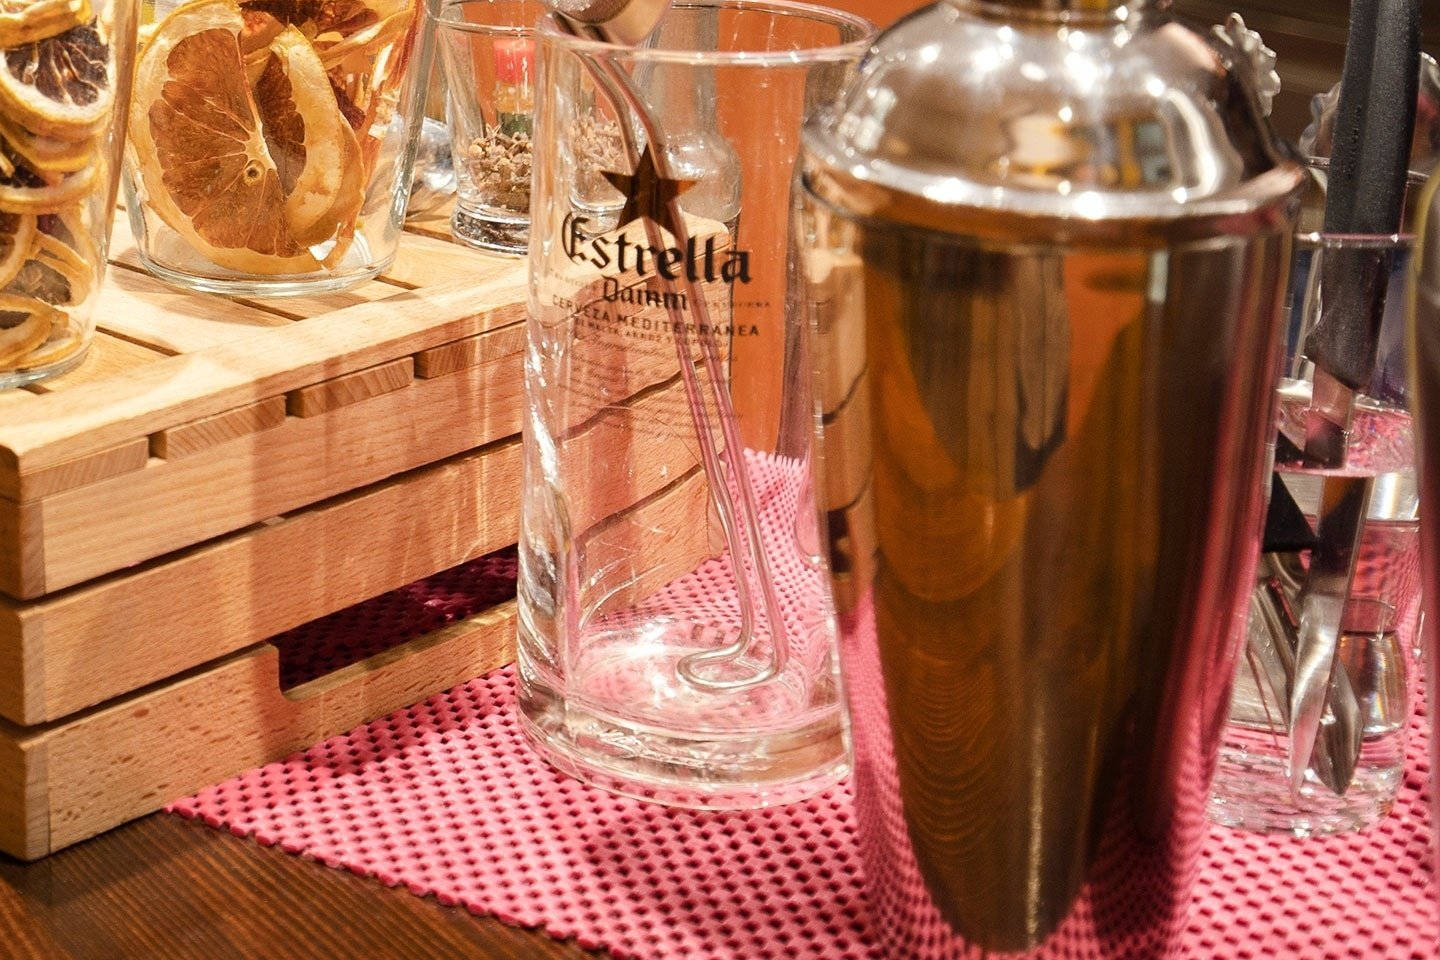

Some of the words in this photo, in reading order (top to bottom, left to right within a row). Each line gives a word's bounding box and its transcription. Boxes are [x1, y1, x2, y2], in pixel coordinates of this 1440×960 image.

[562, 212, 751, 285] Estrella
[602, 274, 687, 311] Damm
[552, 293, 611, 322] CERVEZA
[617, 313, 760, 337] MEDITERRANEA
